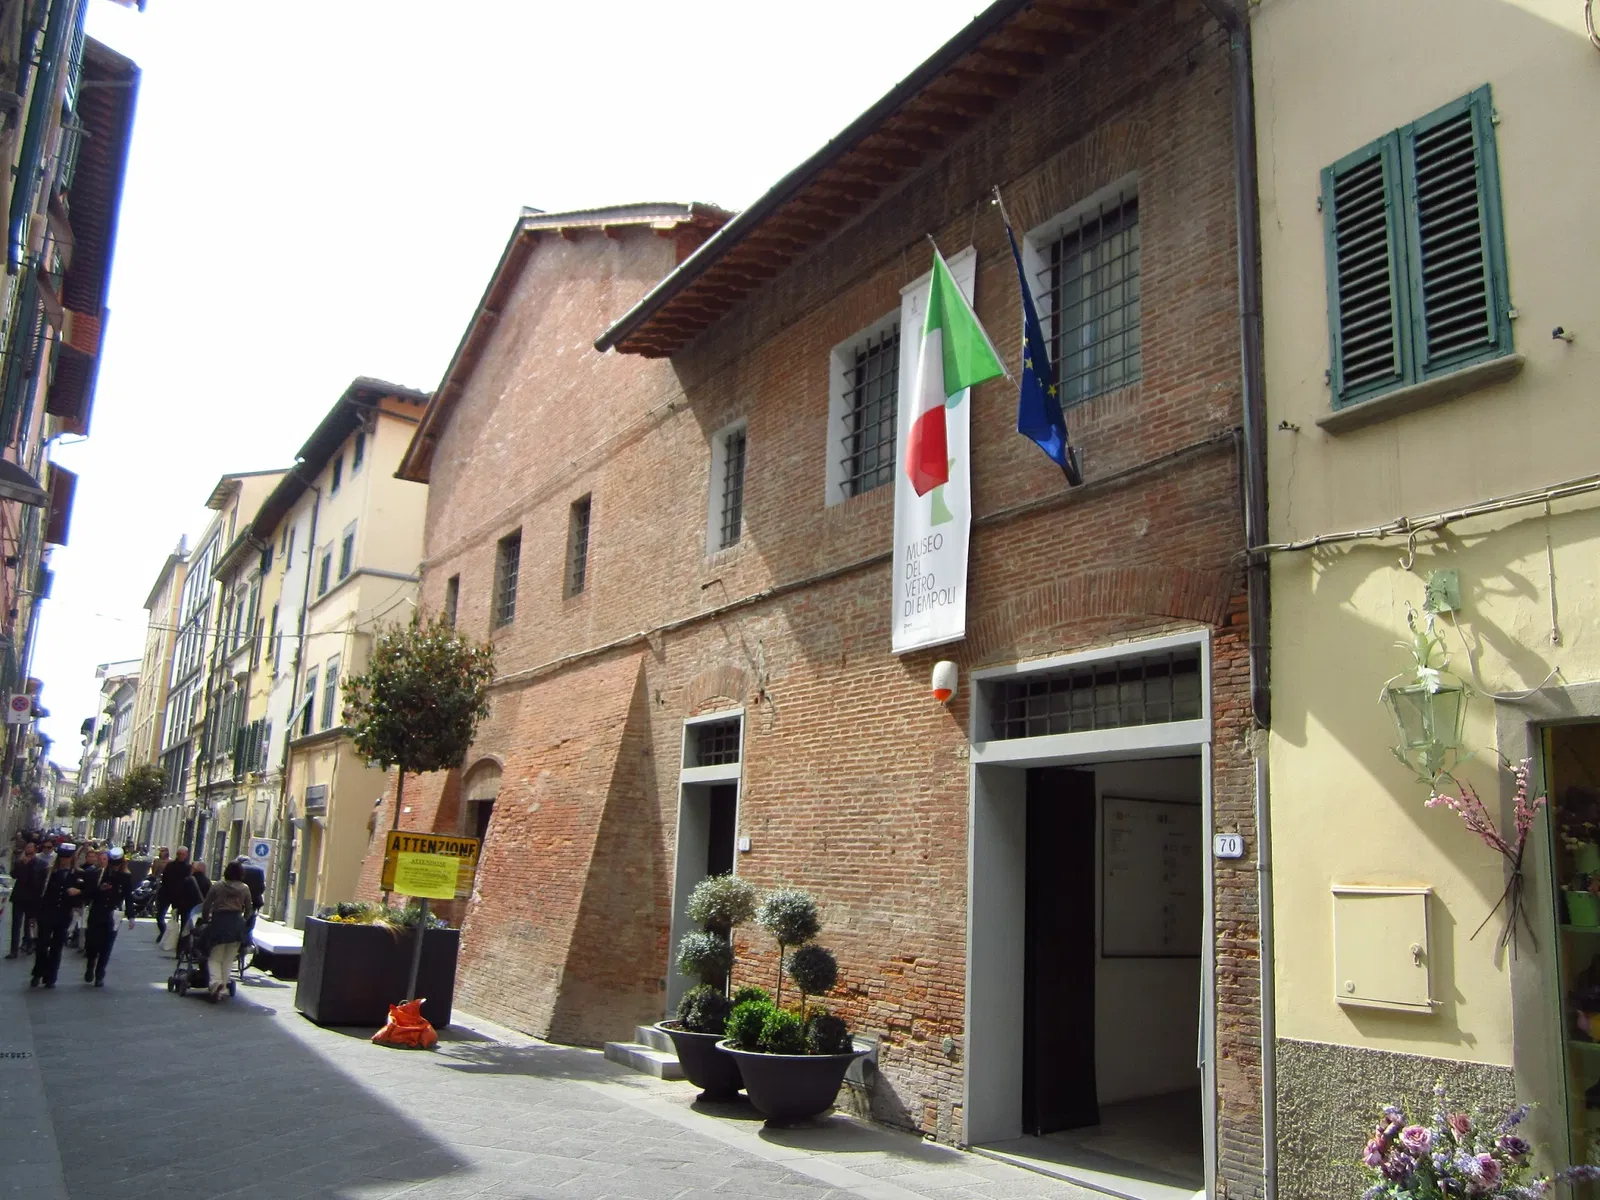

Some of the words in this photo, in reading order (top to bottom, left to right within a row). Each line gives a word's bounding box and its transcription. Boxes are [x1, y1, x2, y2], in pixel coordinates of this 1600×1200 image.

[906, 533, 943, 561] MUSEO
[905, 560, 921, 580] DEL
[905, 573, 935, 597] VETRO
[904, 600, 914, 617] DI
[917, 586, 956, 613] EMPOLI
[392, 836, 476, 857] ATTENZIONE
[1220, 838, 1236, 852] 70
